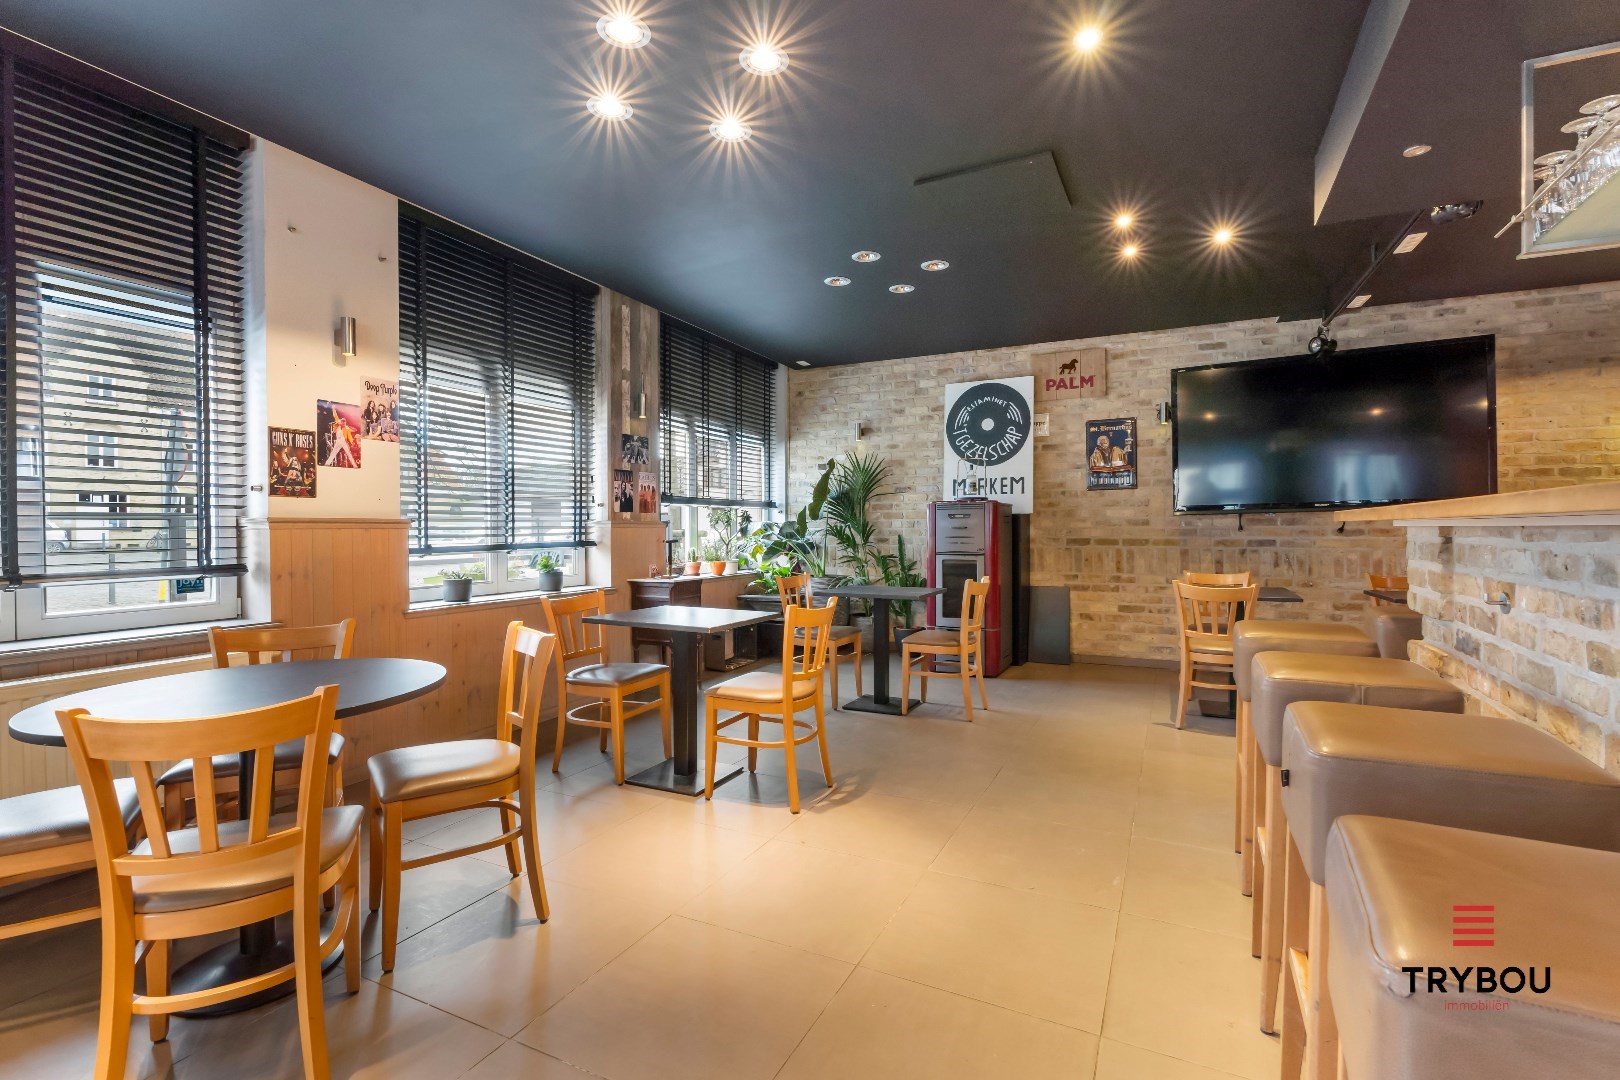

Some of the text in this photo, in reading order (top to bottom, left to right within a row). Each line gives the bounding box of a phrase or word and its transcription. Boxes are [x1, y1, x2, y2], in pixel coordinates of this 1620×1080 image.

[364, 380, 398, 398] Deep Purple
[1045, 375, 1094, 392] PALM
[966, 396, 1008, 412] ESTAMINET
[272, 431, 288, 446] GUNS
[295, 434, 314, 449] ROSES
[952, 476, 1025, 496] MRKEM
